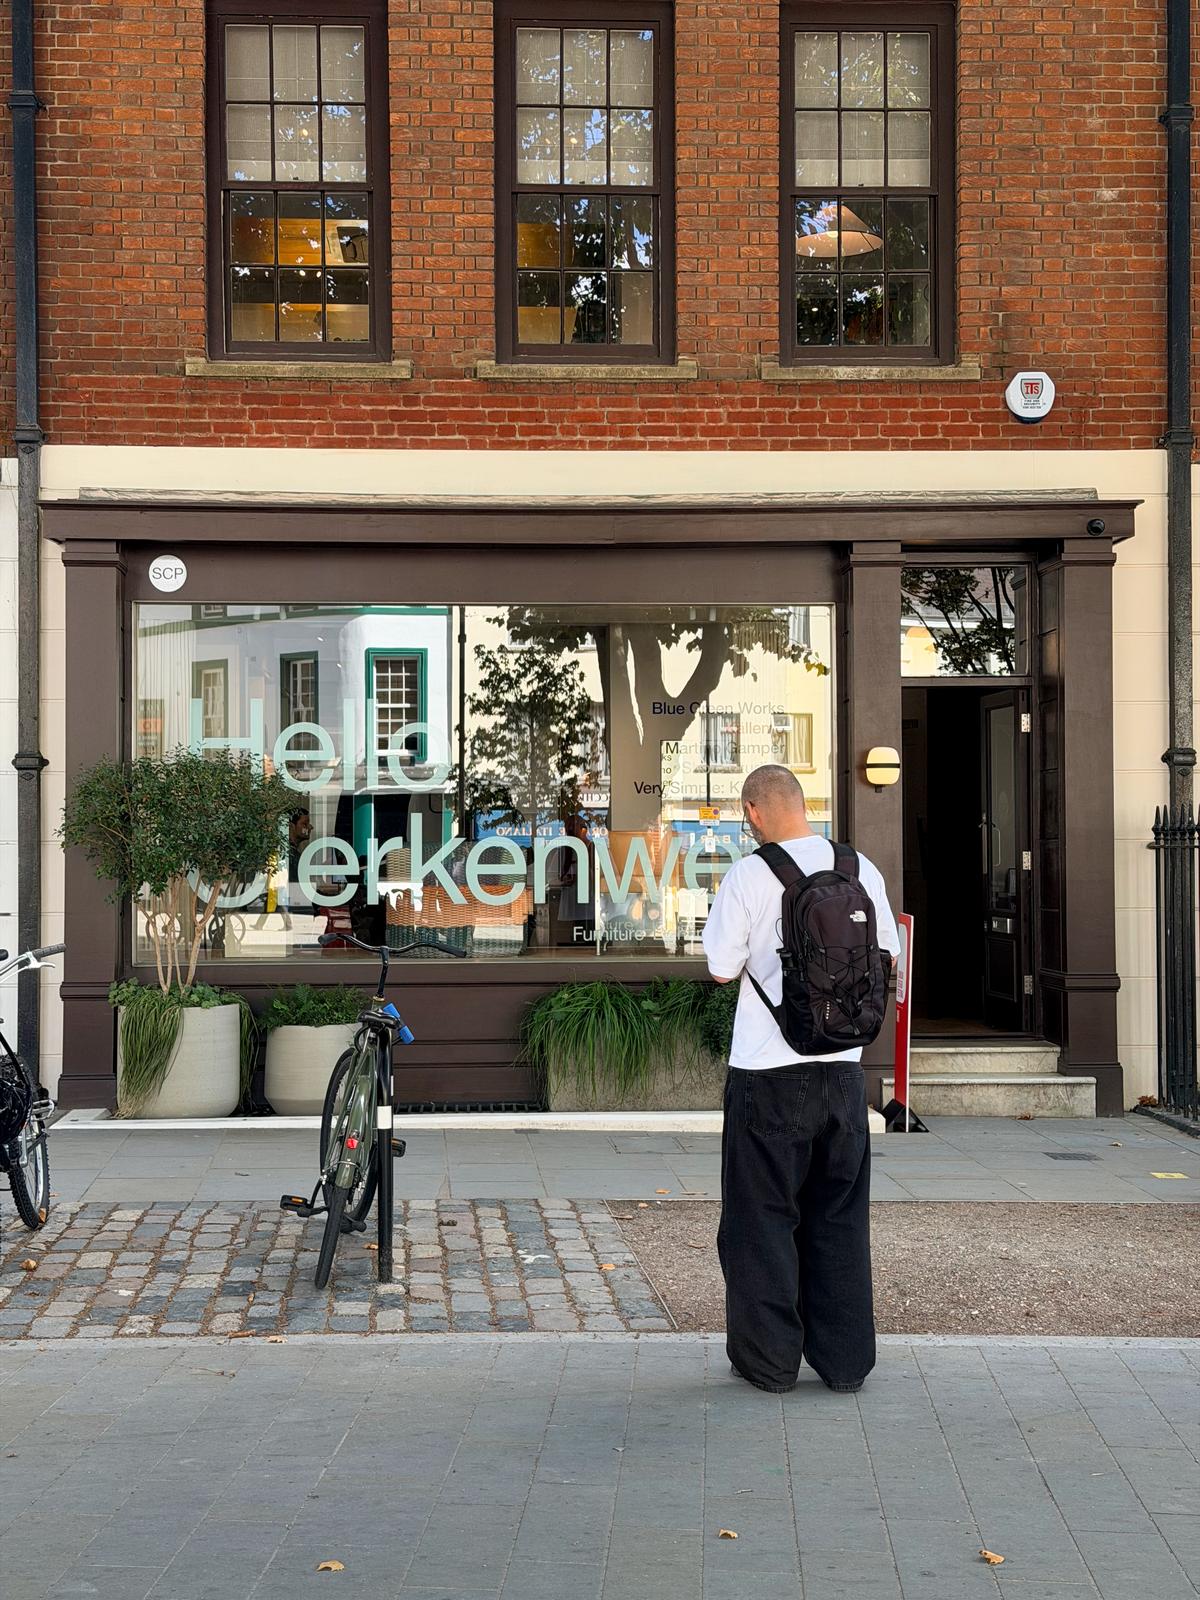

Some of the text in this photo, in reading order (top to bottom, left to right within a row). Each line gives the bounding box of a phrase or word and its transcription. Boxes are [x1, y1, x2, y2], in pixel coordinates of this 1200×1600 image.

[1023, 382, 1041, 395] ITS
[152, 567, 184, 580] SCP
[652, 702, 685, 715] Blue
[738, 701, 785, 715] Works
[190, 698, 452, 793] Hello
[727, 741, 785, 757] Gamper
[634, 781, 666, 797] Very
[573, 926, 646, 941] Furniture
